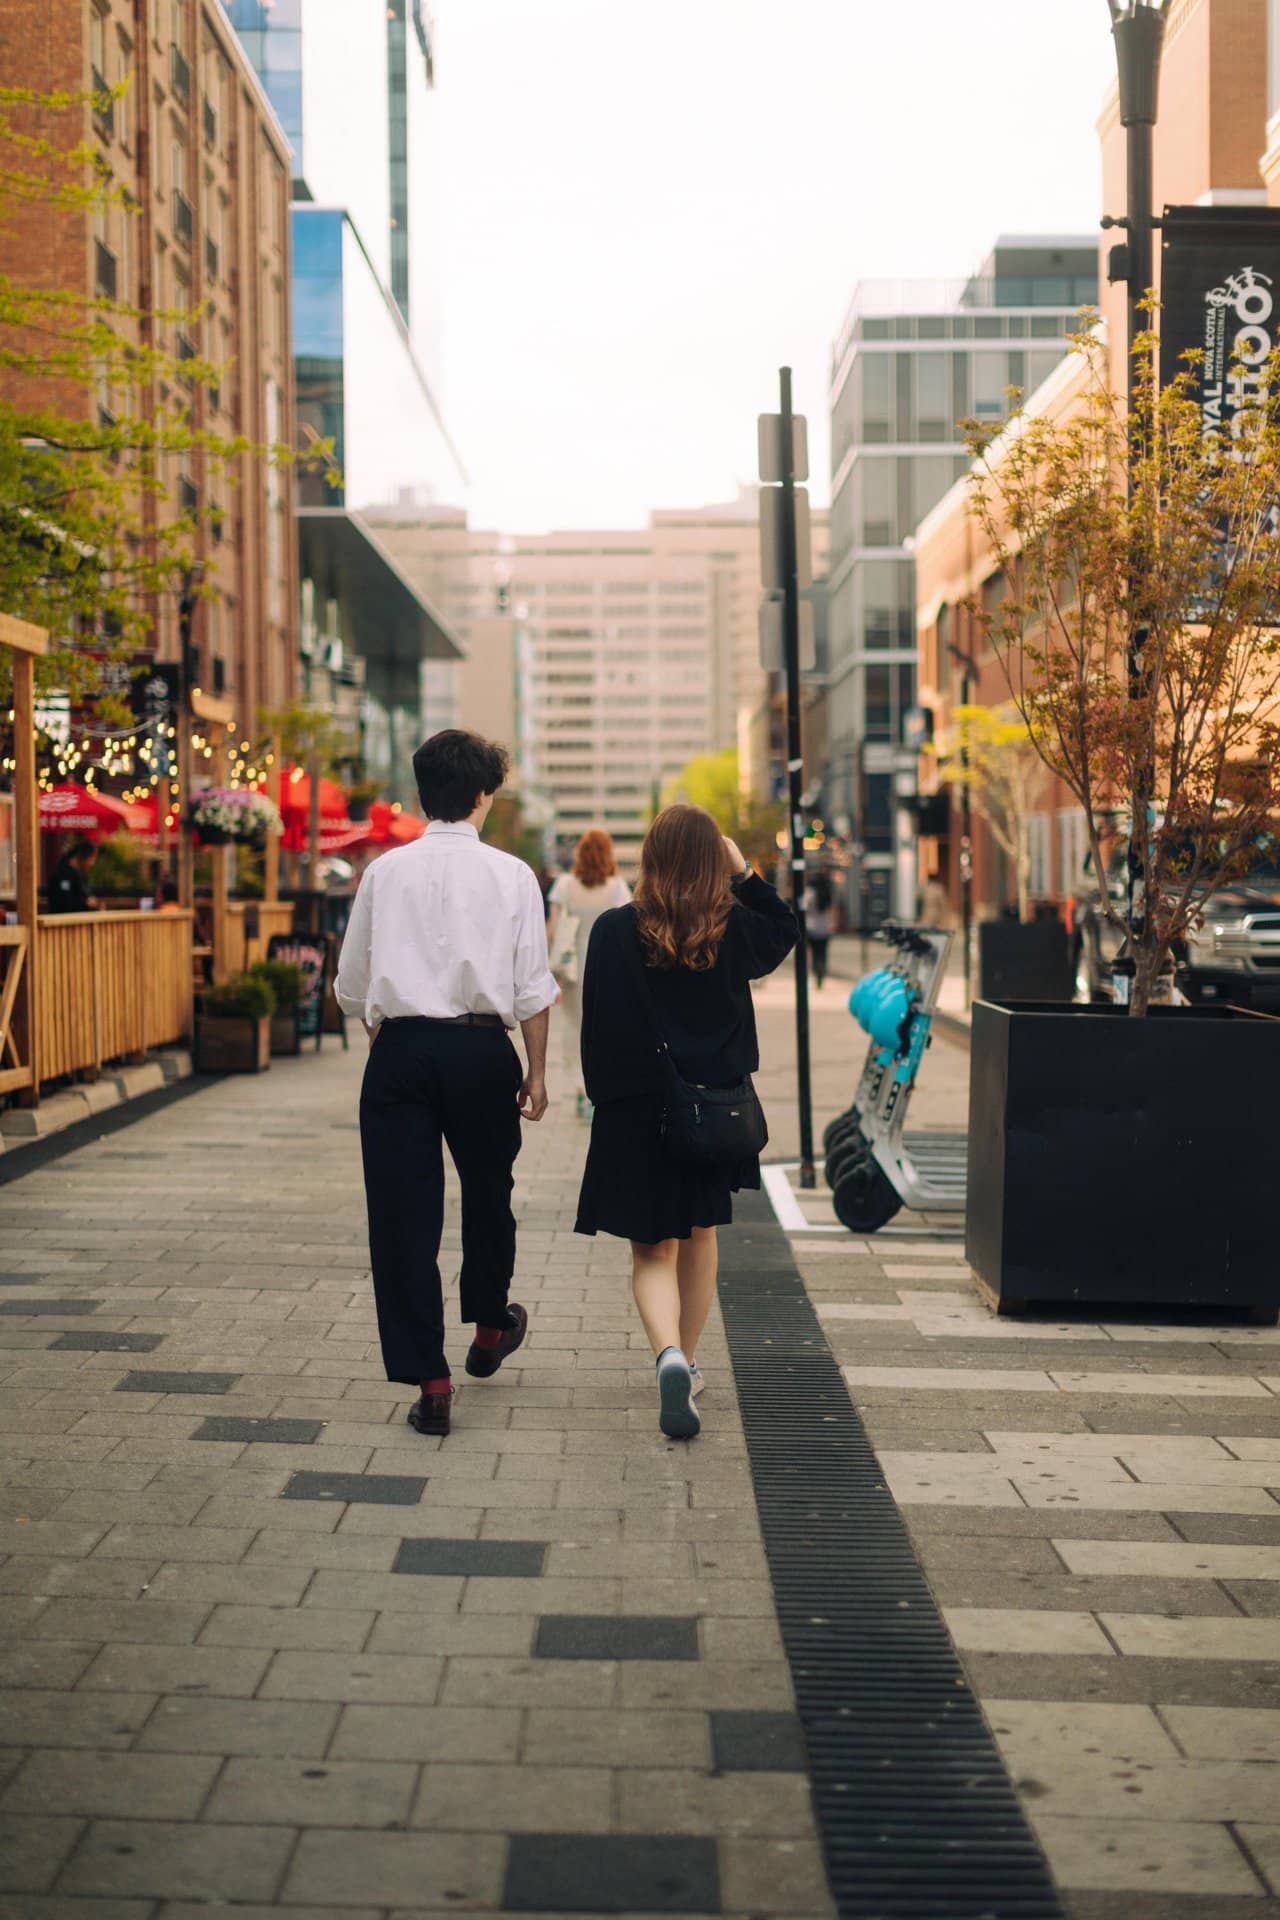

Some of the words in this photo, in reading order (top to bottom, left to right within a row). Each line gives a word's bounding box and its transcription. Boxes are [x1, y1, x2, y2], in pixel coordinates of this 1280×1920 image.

[1205, 307, 1217, 347] SCOTIA
[1214, 307, 1226, 381] INTERNATIONAL
[1204, 349, 1215, 380] NOVA
